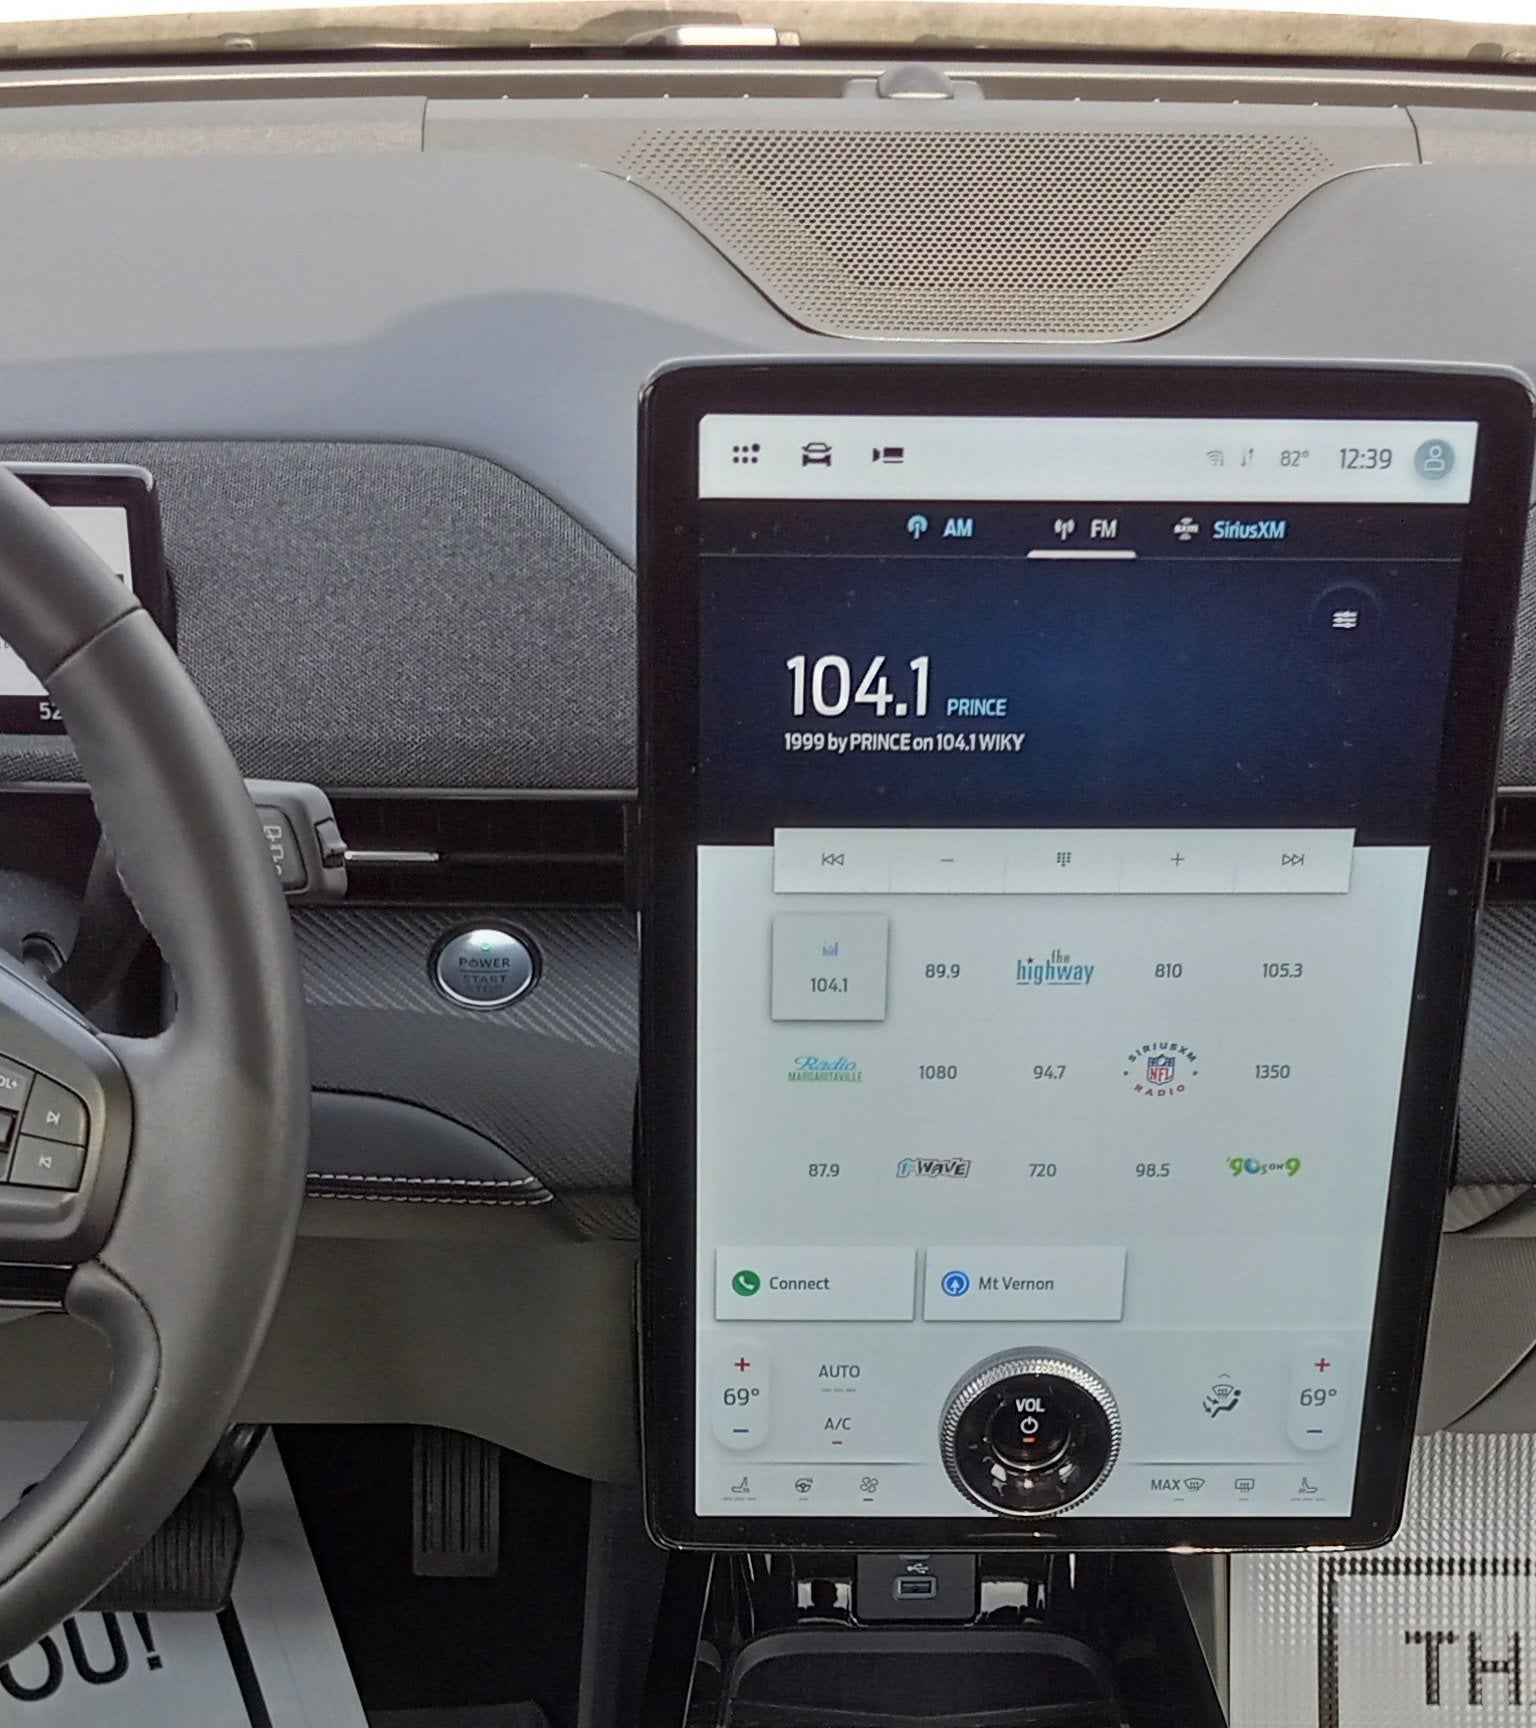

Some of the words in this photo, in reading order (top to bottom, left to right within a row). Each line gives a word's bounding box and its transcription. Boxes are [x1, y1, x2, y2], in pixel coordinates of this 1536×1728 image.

[1280, 449, 1309, 468] 82°
[1339, 448, 1392, 470] 12:39
[943, 518, 973, 538] AM
[1091, 519, 1117, 539] FM
[1213, 519, 1286, 540] SiriusXM
[787, 655, 929, 717] 104.1
[947, 698, 1007, 717] PRINCE
[785, 733, 824, 751] 1999
[828, 733, 848, 753] by
[850, 733, 911, 751] PRINCE
[913, 736, 933, 751] on
[936, 733, 975, 751] 104.1
[979, 734, 1025, 751] WIKY
[459, 957, 510, 969] POWER
[925, 963, 961, 979] 89.9
[1016, 957, 1095, 985] highway
[1154, 963, 1183, 978] 810
[1262, 963, 1303, 979] 105.3
[463, 975, 506, 984] START
[810, 977, 849, 993] 104.1
[794, 1055, 857, 1071] Radio
[918, 1064, 957, 1080] 1080
[1032, 1064, 1066, 1080] 94.7
[1149, 1067, 1172, 1082] NFL
[1255, 1064, 1291, 1080] 1350
[1134, 1084, 1185, 1096] RADIO
[808, 1162, 840, 1178] 87.9
[1028, 1163, 1057, 1178] 720
[1136, 1162, 1170, 1178] 98.5
[769, 1276, 830, 1292] Connect
[978, 1276, 997, 1292] Mt
[1002, 1276, 1054, 1292] Vernon
[818, 1364, 861, 1379] AUTO
[723, 1387, 760, 1406] 69°
[1299, 1387, 1337, 1406] 69°
[1015, 1398, 1044, 1413] VOL
[824, 1416, 851, 1433] A/C
[1151, 1478, 1181, 1492] MAX
